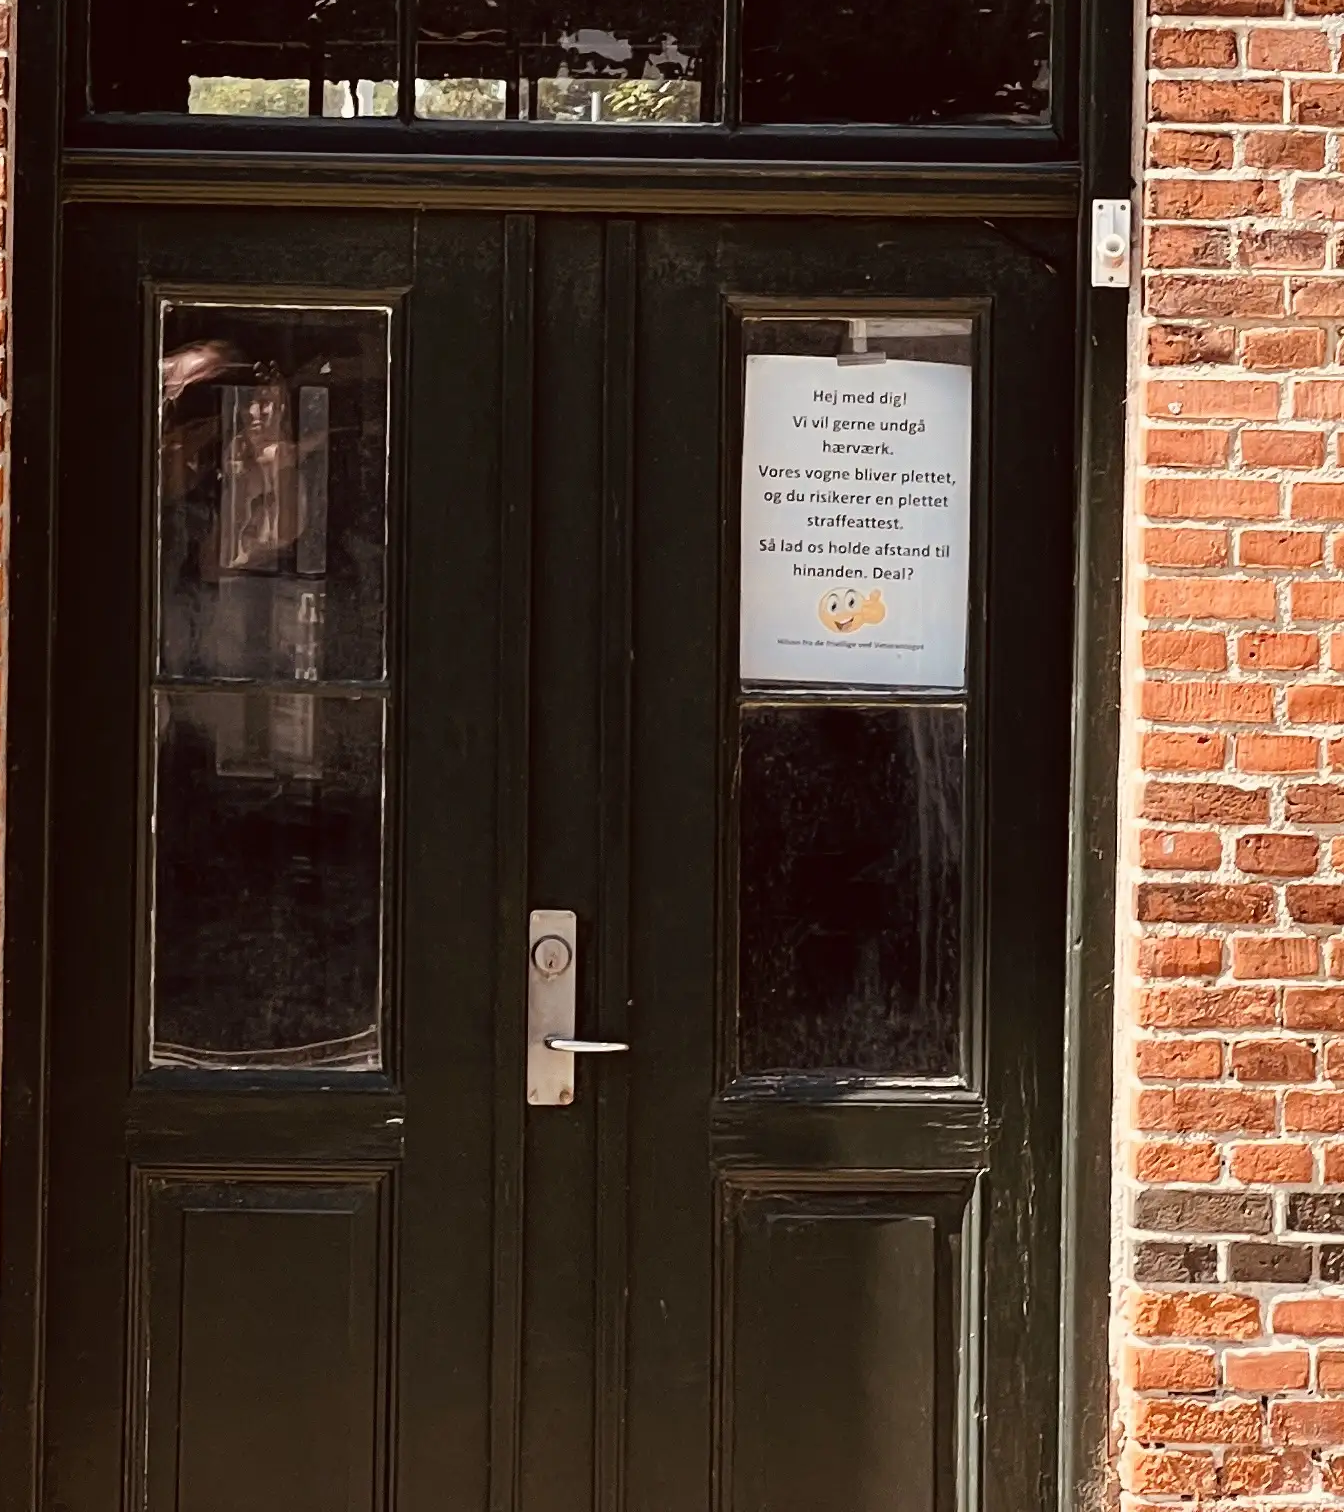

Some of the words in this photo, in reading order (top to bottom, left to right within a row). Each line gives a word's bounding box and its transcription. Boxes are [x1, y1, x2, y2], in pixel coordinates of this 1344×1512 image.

[813, 389, 838, 406] Hej
[842, 391, 875, 404] med
[879, 391, 907, 408] dig!
[792, 414, 808, 429] Vi
[811, 415, 829, 430] vil
[832, 419, 876, 433] gerne
[879, 418, 926, 436] undgå
[821, 439, 895, 456] hærværk.
[758, 464, 801, 480] Vores
[804, 469, 851, 483] vogne
[854, 467, 898, 484] bliver
[901, 469, 956, 487] plettet,
[763, 491, 782, 505] og
[786, 488, 805, 503] du
[809, 489, 872, 507] risikerer
[875, 495, 894, 507] en
[898, 493, 949, 510] plettet
[806, 513, 905, 531] straffeattest.
[758, 537, 776, 553] Så
[780, 538, 803, 554] lad
[807, 543, 824, 555] os
[828, 540, 871, 557] holde
[874, 542, 931, 559] afstand
[934, 543, 950, 559] til
[792, 563, 868, 580] hinanden.
[872, 565, 915, 581] Deal?
